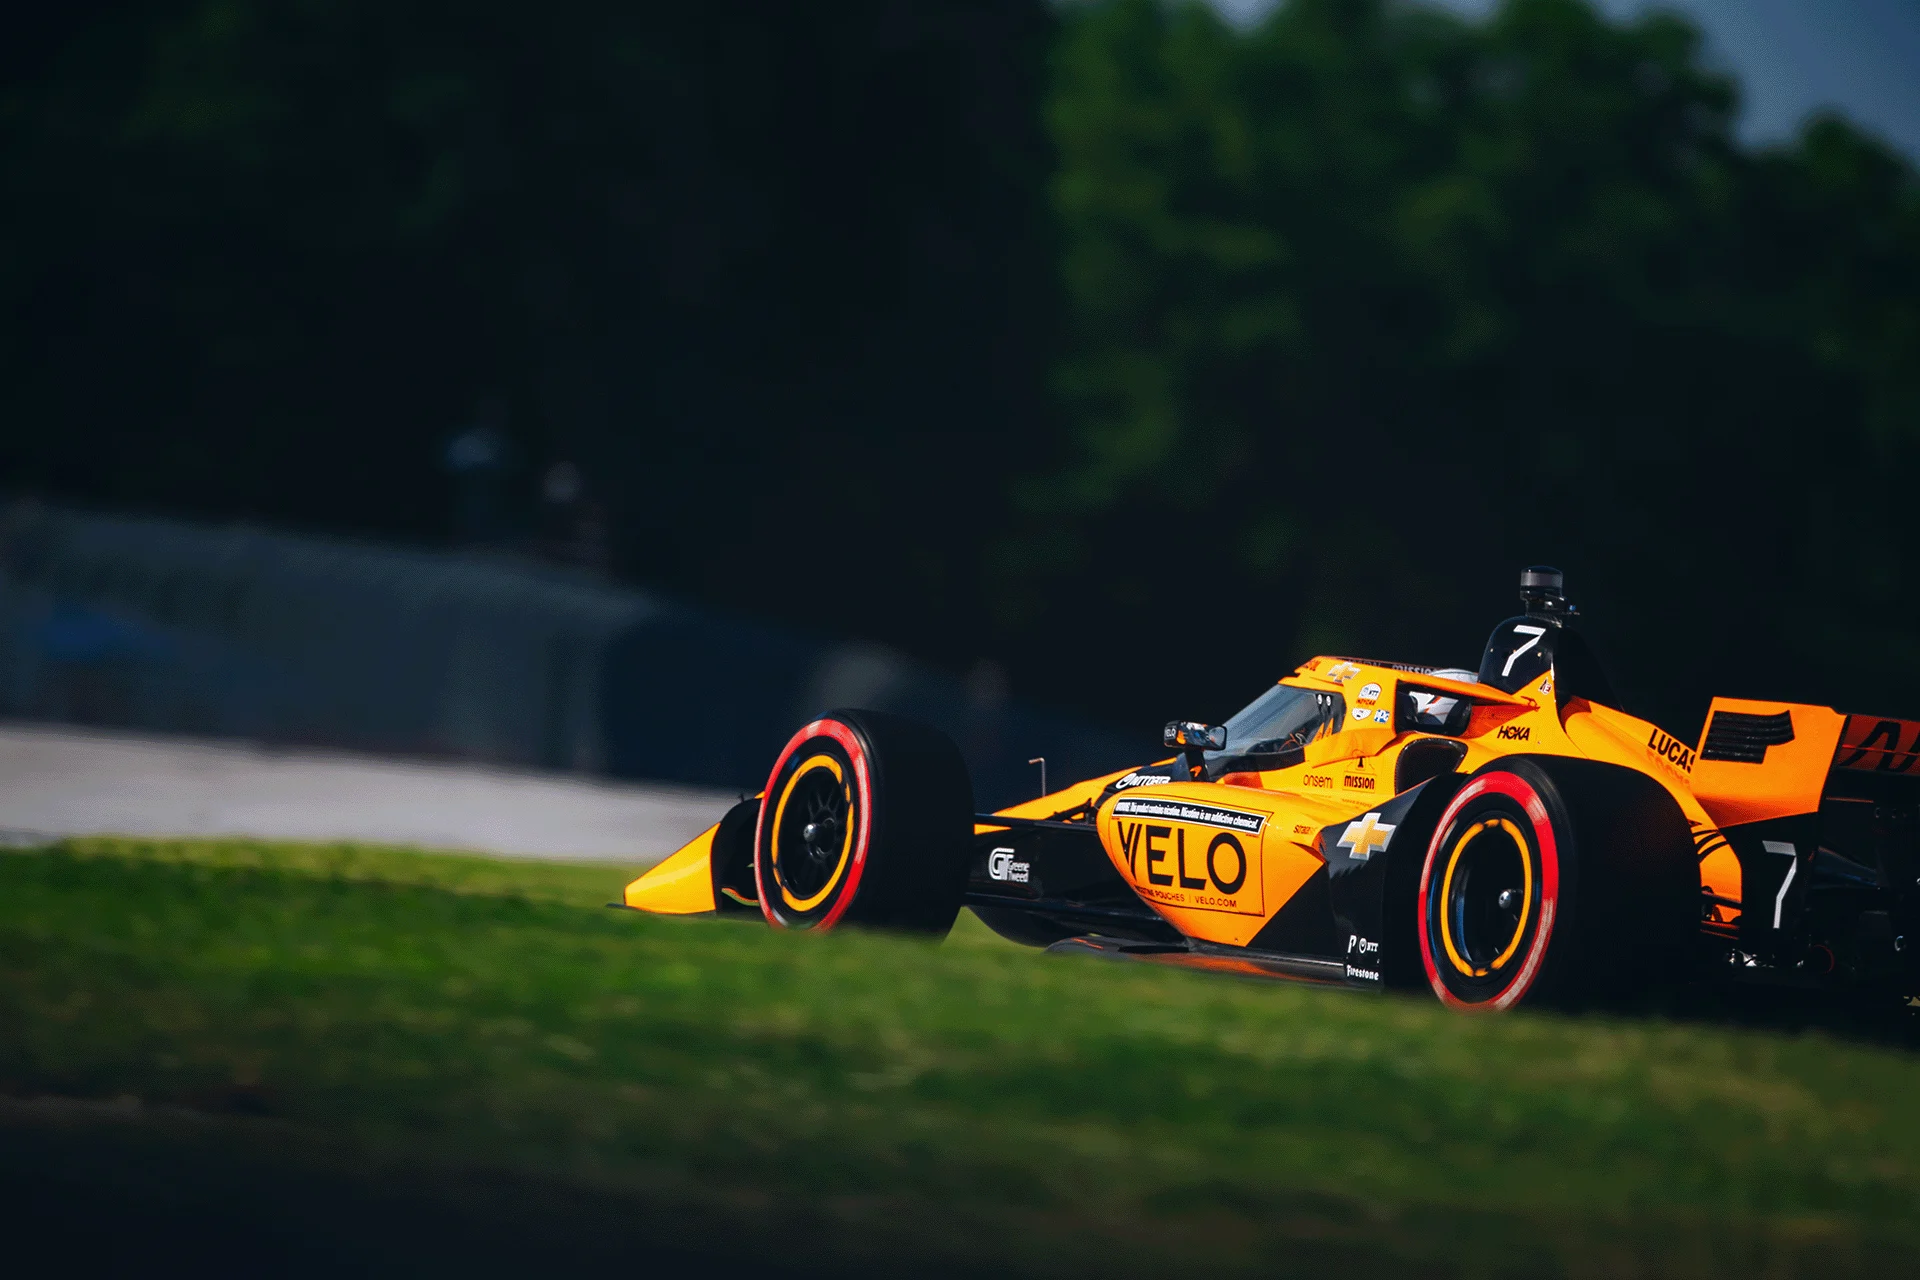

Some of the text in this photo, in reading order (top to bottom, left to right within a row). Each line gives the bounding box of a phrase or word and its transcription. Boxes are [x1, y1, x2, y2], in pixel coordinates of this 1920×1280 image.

[1502, 624, 1546, 677] 7
[1497, 726, 1530, 741] HOKA
[1181, 807, 1200, 819] Nicotine
[1211, 812, 1234, 825] addictive
[1117, 821, 1247, 895] VELO
[1762, 840, 1797, 929] 7
[1154, 890, 1185, 902] POUCHES
[1195, 896, 1237, 908] VELO.COM
[1346, 964, 1379, 980] Firestone
